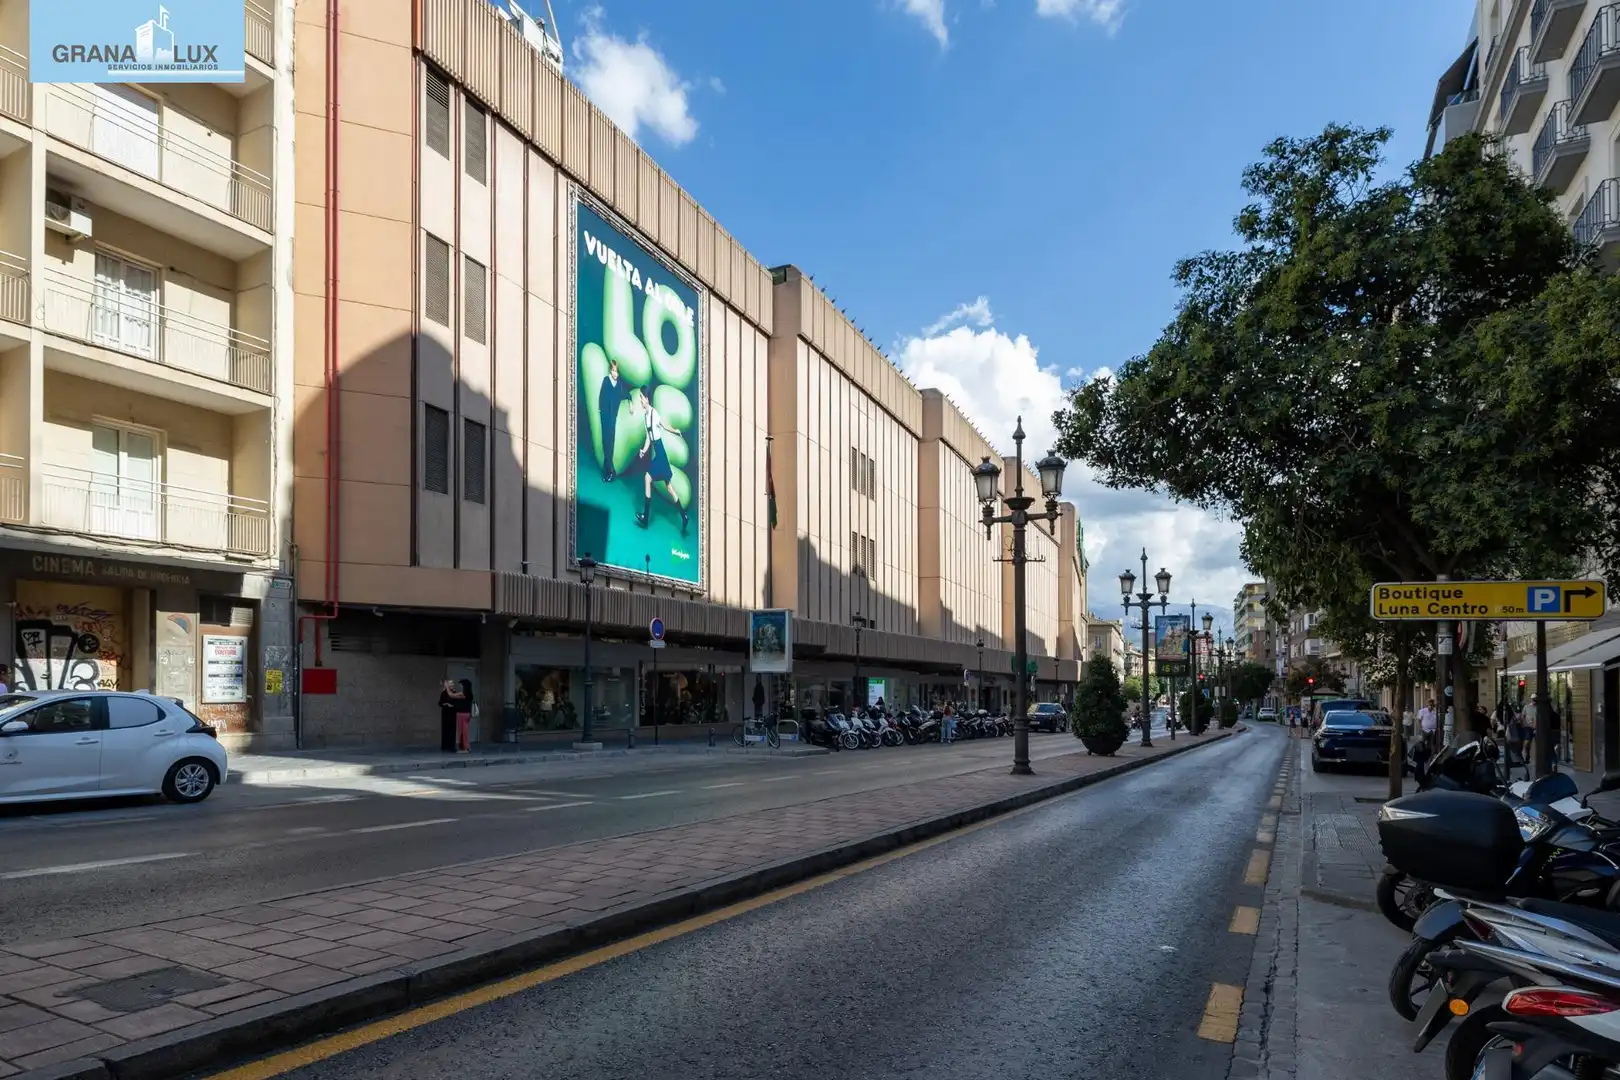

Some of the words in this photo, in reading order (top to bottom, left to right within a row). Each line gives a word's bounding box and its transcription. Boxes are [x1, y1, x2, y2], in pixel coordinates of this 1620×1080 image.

[584, 230, 643, 290] VUELTA
[32, 556, 97, 576] CINEMA
[1379, 587, 1463, 601] Boutique
[1534, 588, 1556, 611] P
[1379, 602, 1419, 615] Luna
[1427, 602, 1488, 615] Centro
